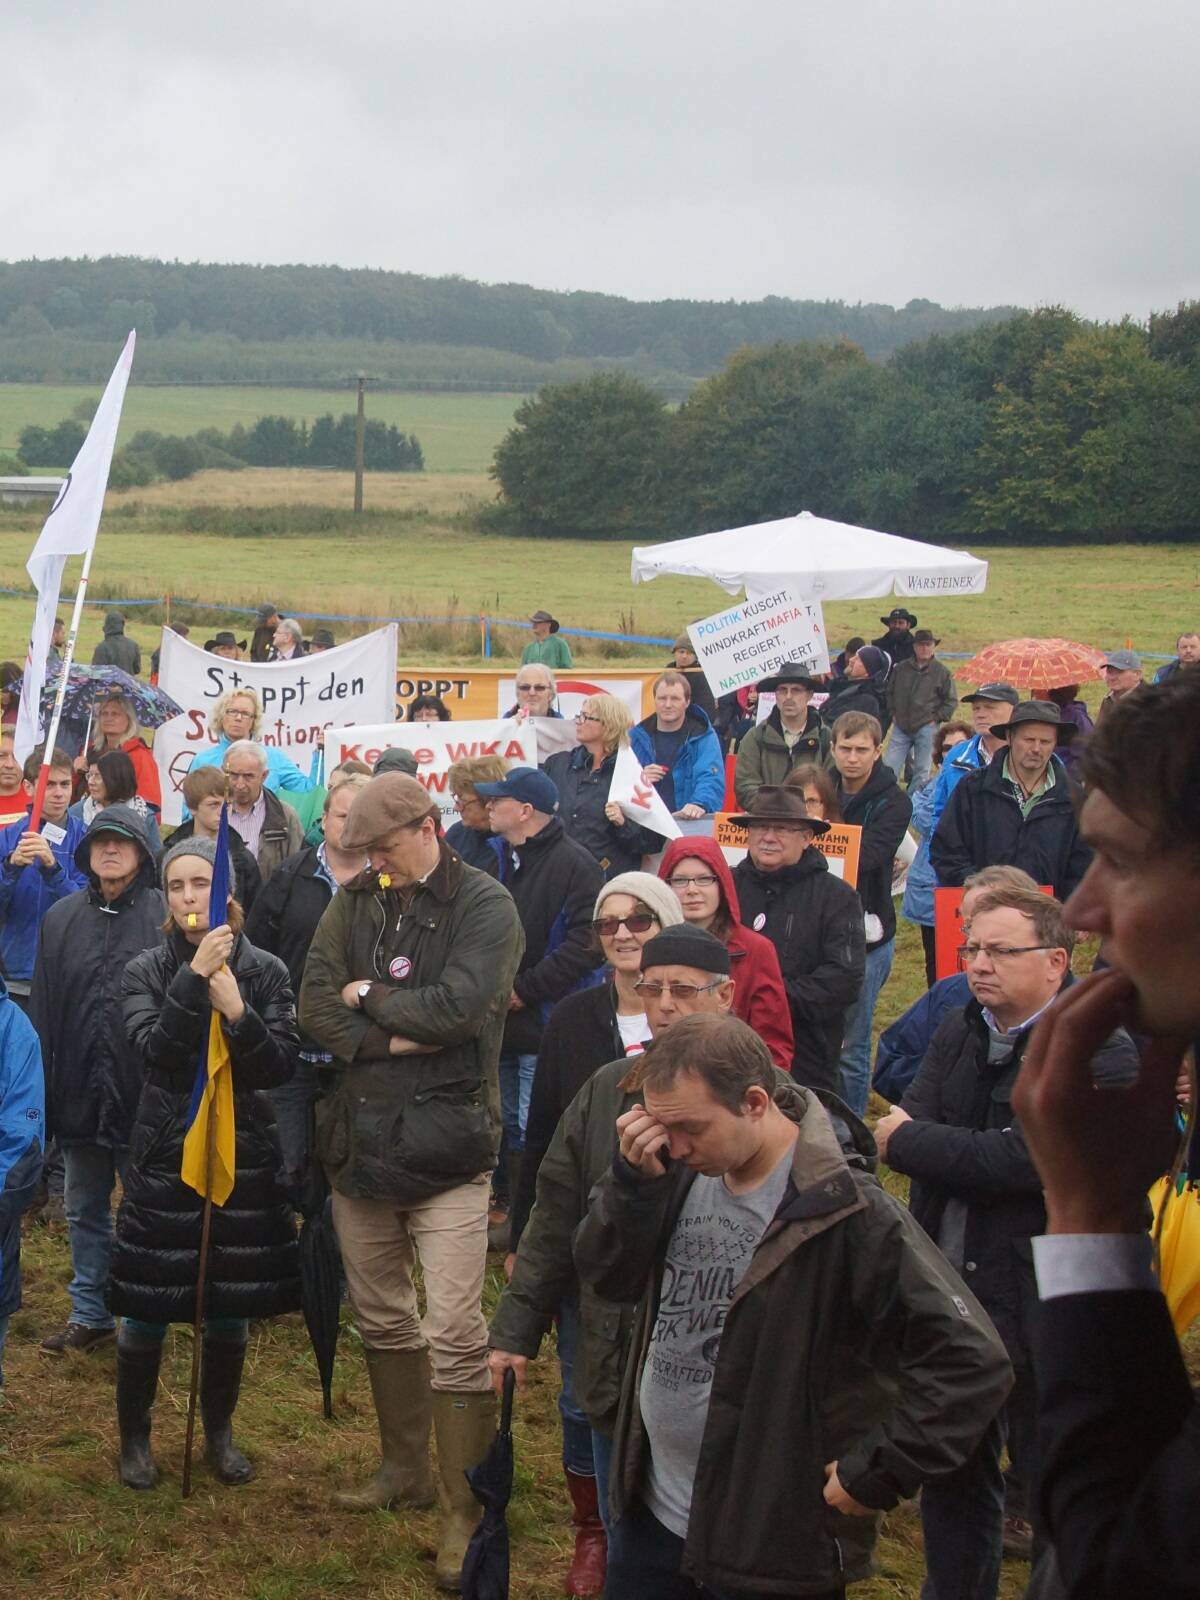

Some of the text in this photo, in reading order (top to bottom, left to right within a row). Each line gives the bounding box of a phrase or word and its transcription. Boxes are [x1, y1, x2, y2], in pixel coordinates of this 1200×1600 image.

[908, 576, 973, 589] WARSTEINER
[697, 611, 742, 638] POLITIK
[742, 590, 792, 619] KUSCHT,
[701, 607, 802, 657] WINDKRAFTMAFIA
[733, 635, 786, 664] REGIERT,
[719, 666, 759, 691] NATUR
[759, 642, 814, 673] VERLIERT
[203, 667, 364, 713] Stppt den
[340, 740, 526, 765] Kee WKA
[718, 835, 731, 843] IM
[678, 1215, 755, 1243] TRAIN YOU TO
[652, 1372, 681, 1391] GOODS
